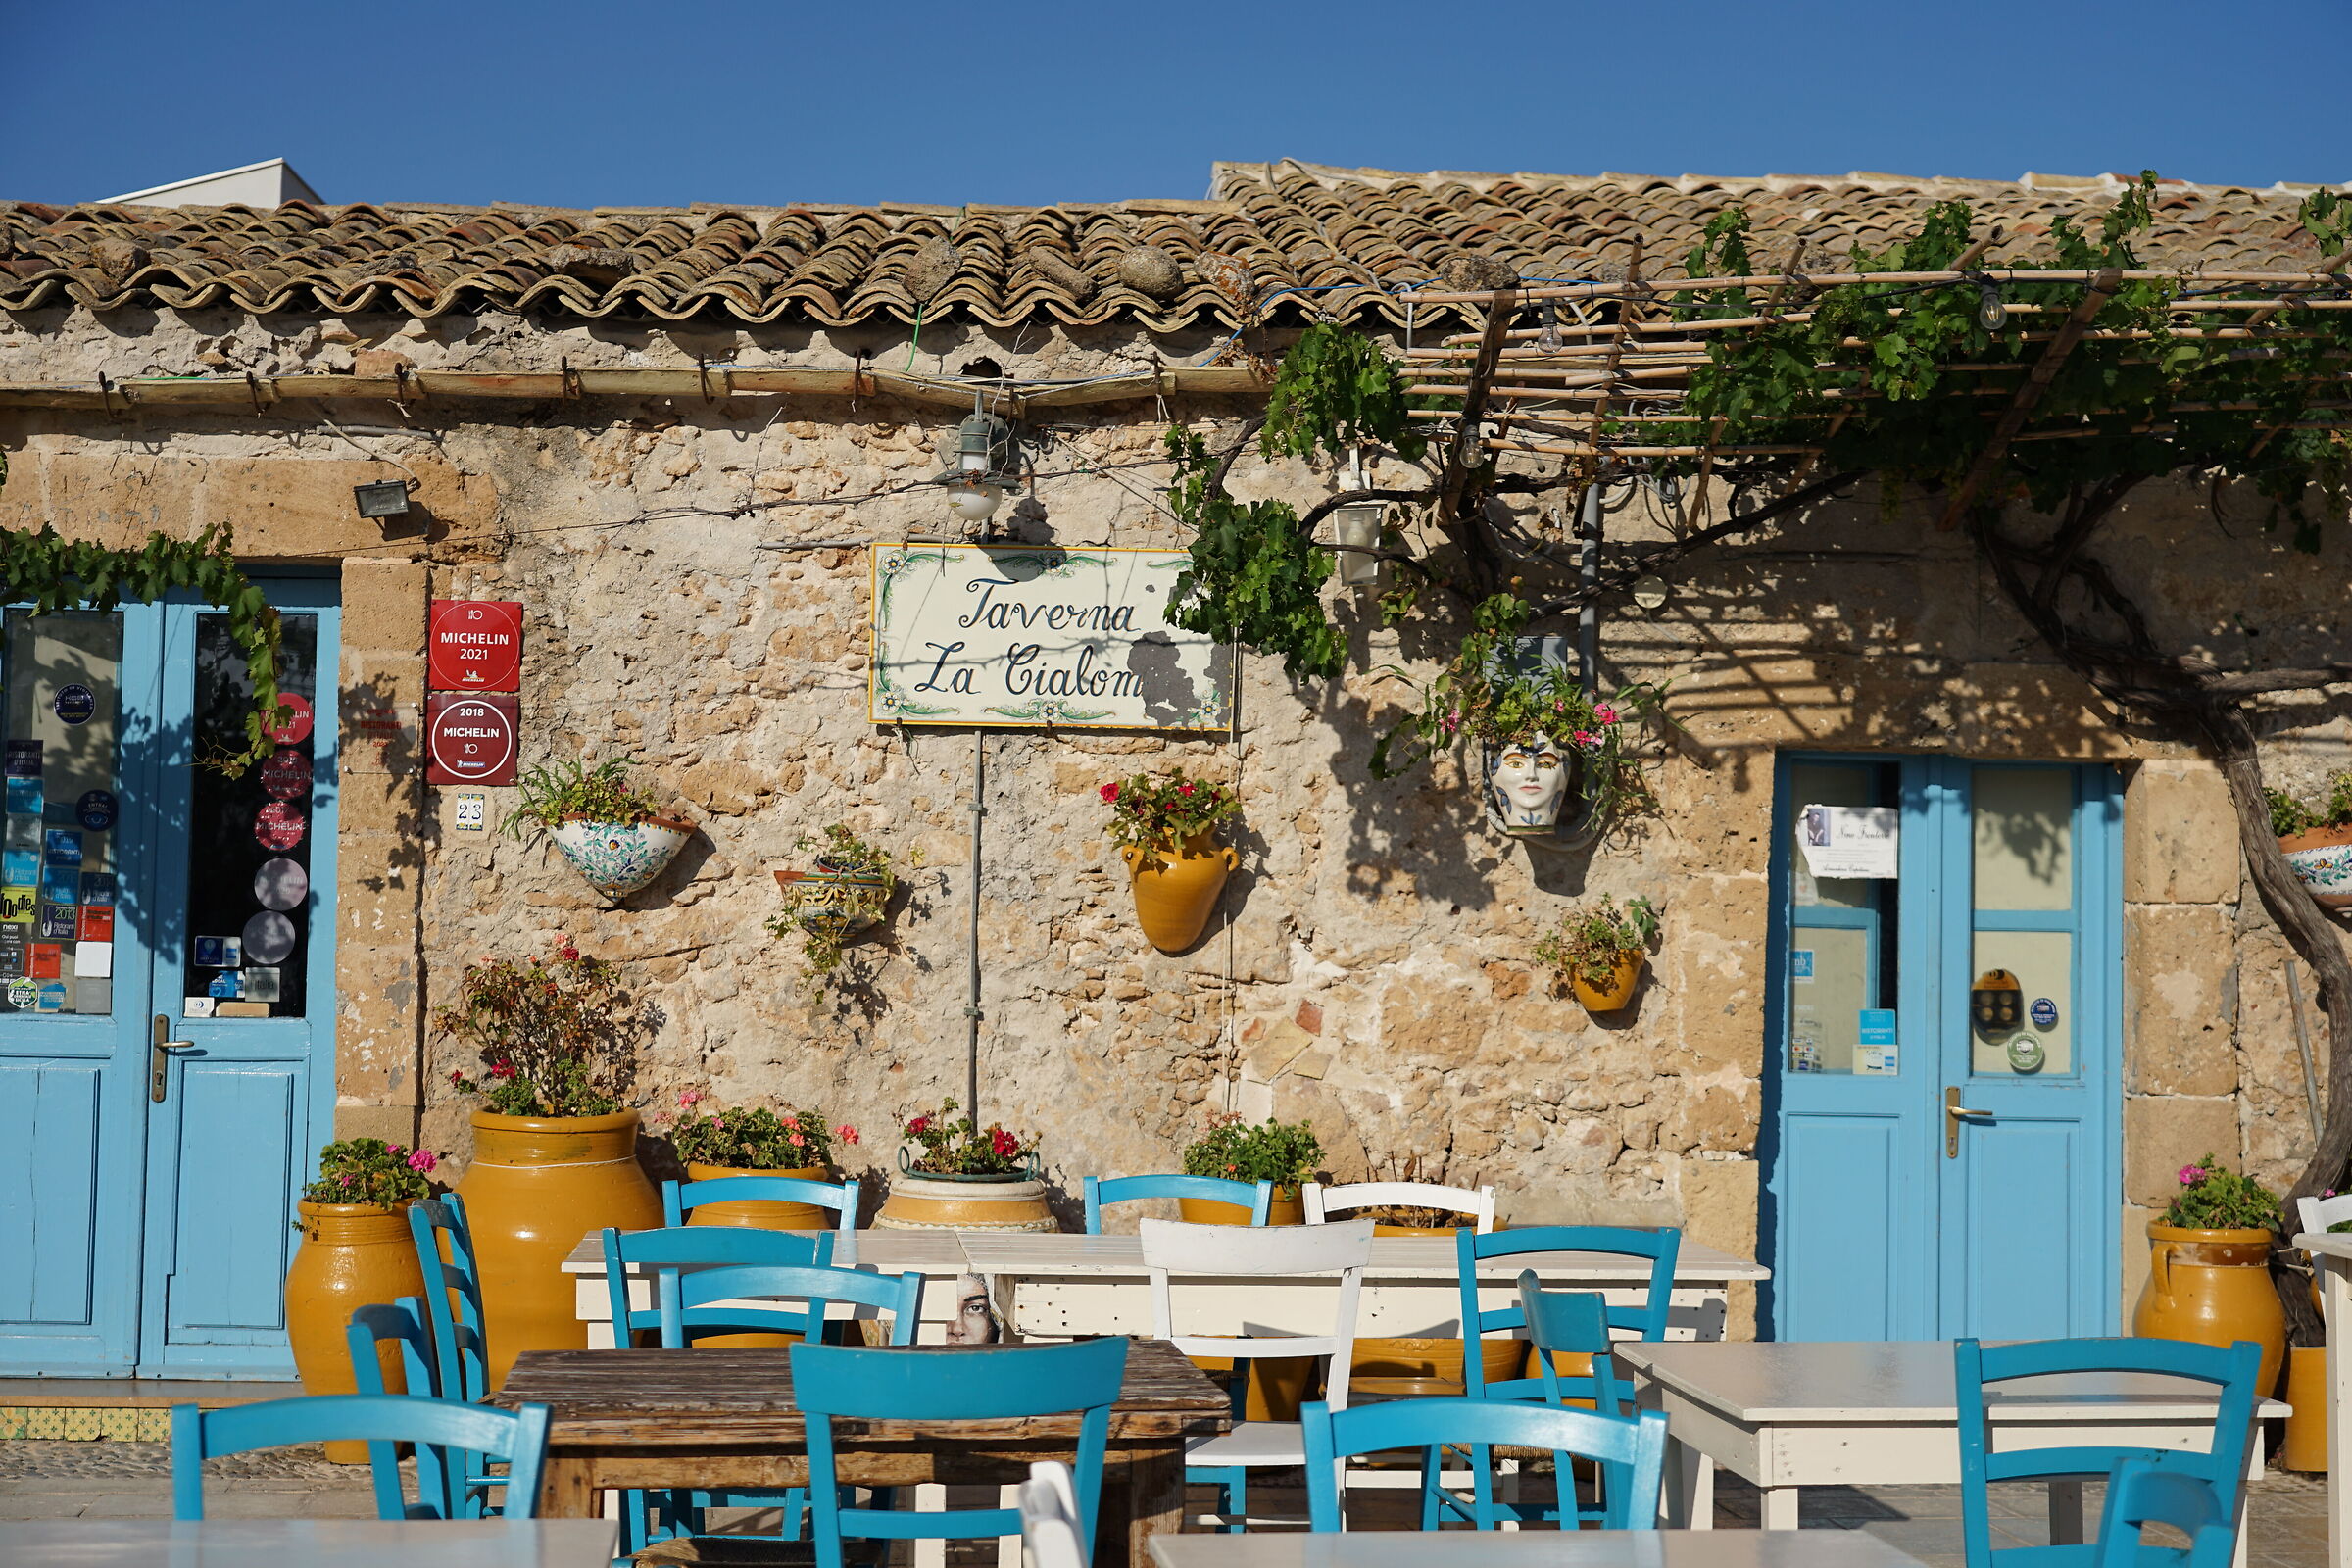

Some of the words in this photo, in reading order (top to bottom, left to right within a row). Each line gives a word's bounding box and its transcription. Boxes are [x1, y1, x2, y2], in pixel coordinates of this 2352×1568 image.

[958, 577, 1142, 632] Taverna
[440, 632, 509, 645] MICHELIN
[460, 648, 488, 660] 2021
[914, 641, 982, 695] La
[1005, 642, 1144, 698] Cialom
[460, 708, 484, 717] 2018
[443, 727, 500, 738] MICHELIN
[263, 769, 311, 779] MICHELIN
[458, 804, 482, 820] 23
[256, 822, 304, 831] MICHELIN
[54, 908, 75, 920] 2013
